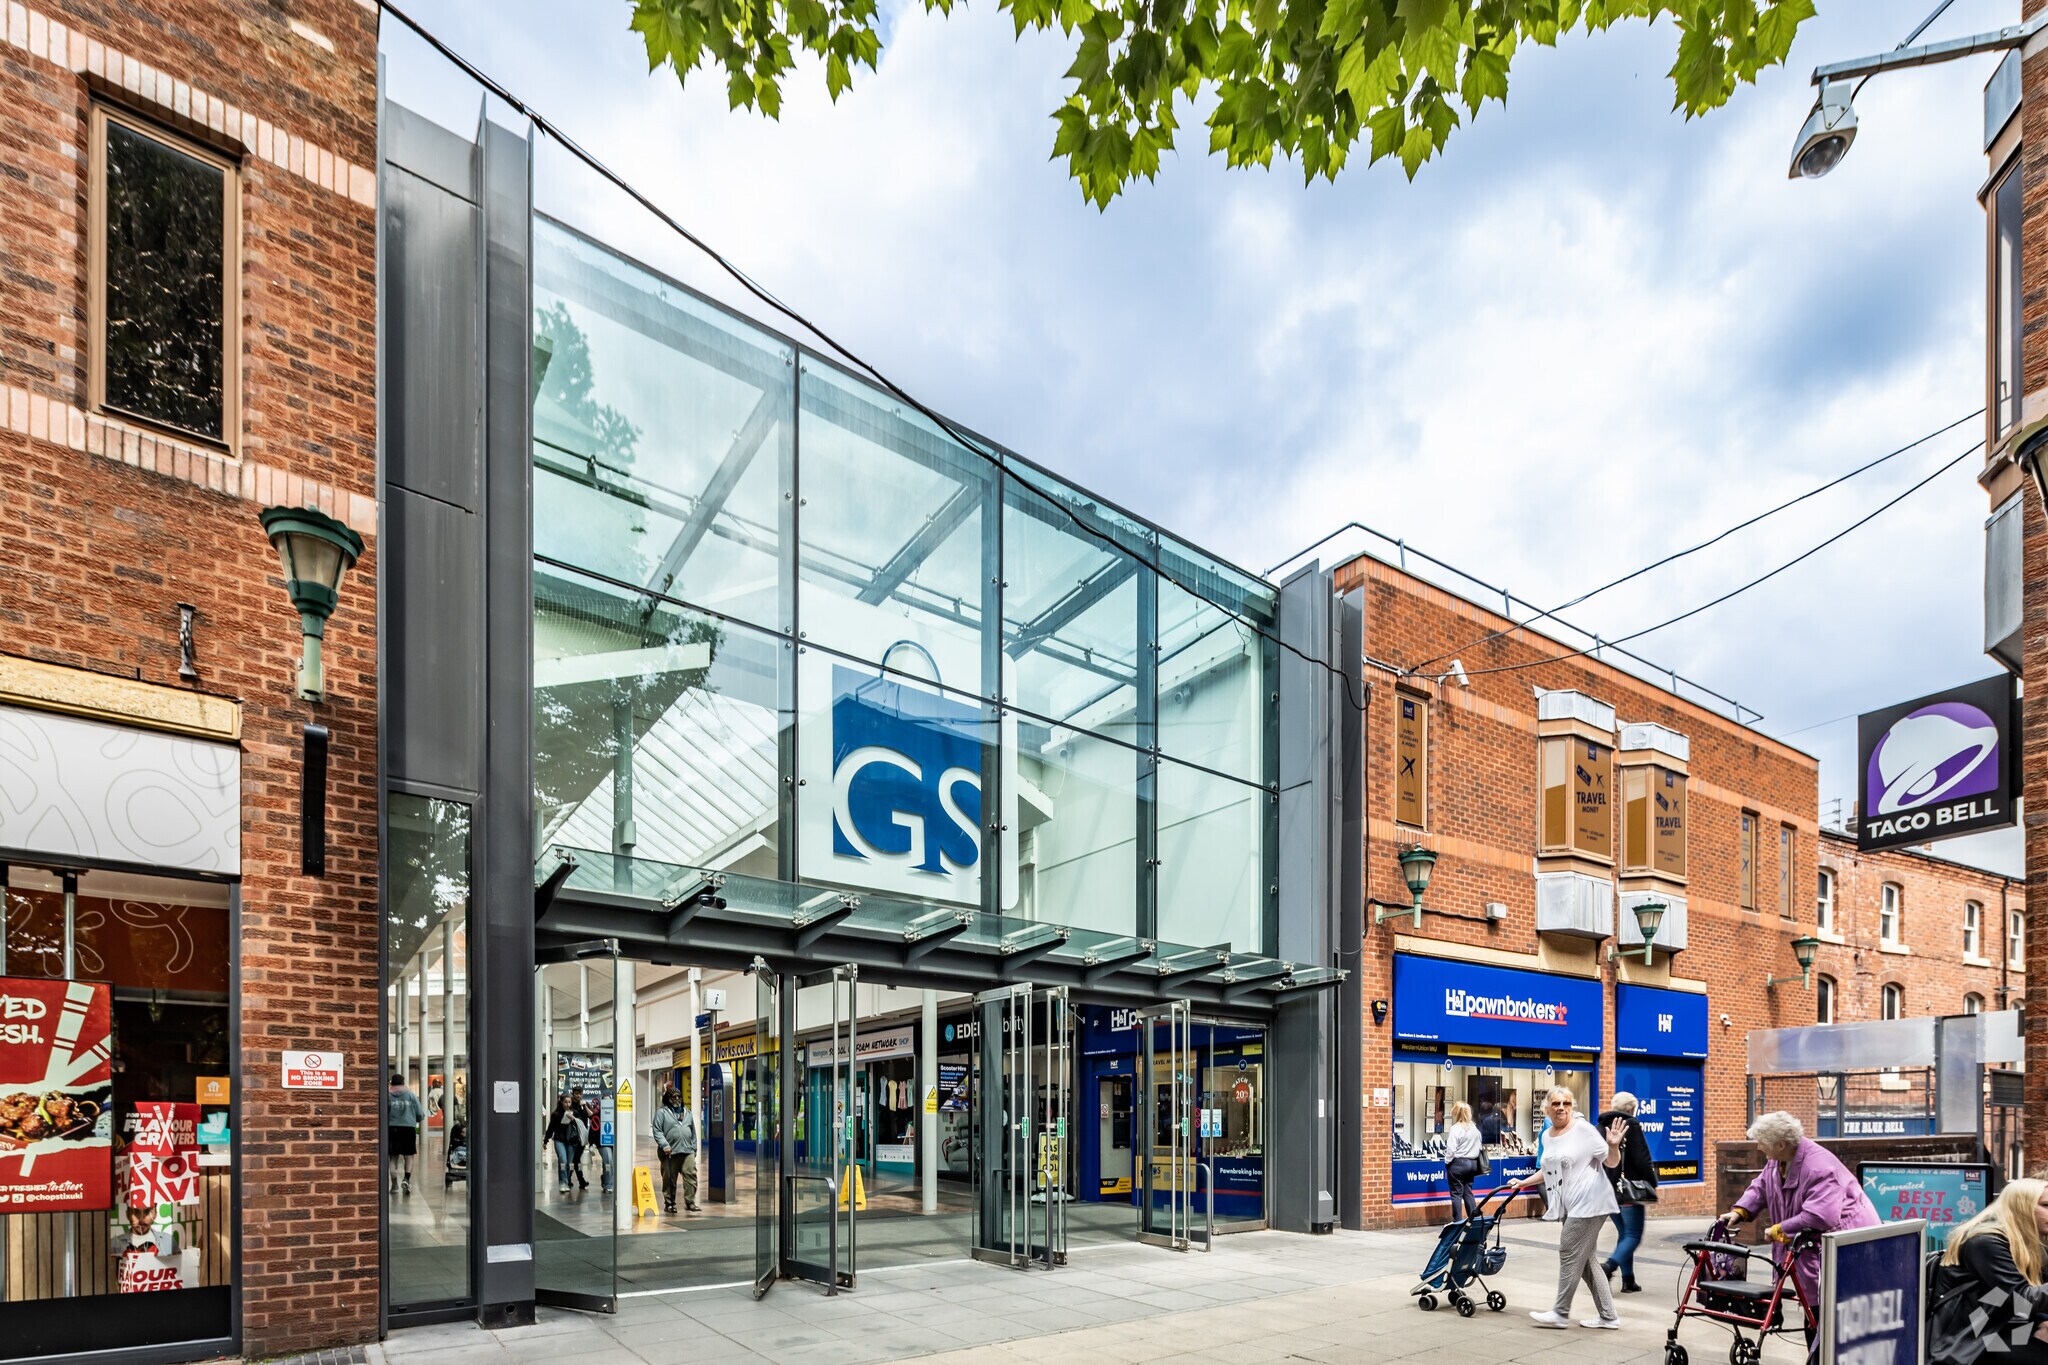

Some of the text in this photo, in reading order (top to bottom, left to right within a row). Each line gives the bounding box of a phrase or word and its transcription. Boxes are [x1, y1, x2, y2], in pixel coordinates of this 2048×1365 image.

[1577, 792, 1606, 805] TRAVEL
[833, 745, 981, 880] GS
[1582, 806, 1599, 814] MONEY
[1656, 817, 1681, 828] TRAVEL
[1867, 798, 1999, 839] TACO BELL
[0, 993, 47, 1020] ED
[1446, 988, 1555, 1021] H&T pawnbrokers
[1111, 1009, 1128, 1028] H&T
[1658, 1013, 1673, 1033] H&T
[704, 1038, 755, 1062] ThWorks.co.uk
[871, 1039, 897, 1049] NETWORK
[1232, 1077, 1248, 1089] WATCH
[1641, 1099, 1656, 1114] Sell
[1639, 1122, 1664, 1132] orrow
[1844, 1121, 1905, 1133] THE BLUE BELL
[1043, 1144, 1058, 1153] CAS
[1042, 1163, 1058, 1172] GOL
[1220, 1167, 1251, 1176] Pawnbroking
[1407, 1170, 1444, 1182] We buy gold
[1878, 1181, 1925, 1195] Guaranteed
[26, 1192, 83, 1202] @chopstixuki
[1898, 1190, 1947, 1205] BEST
[1890, 1206, 1954, 1222] RATES
